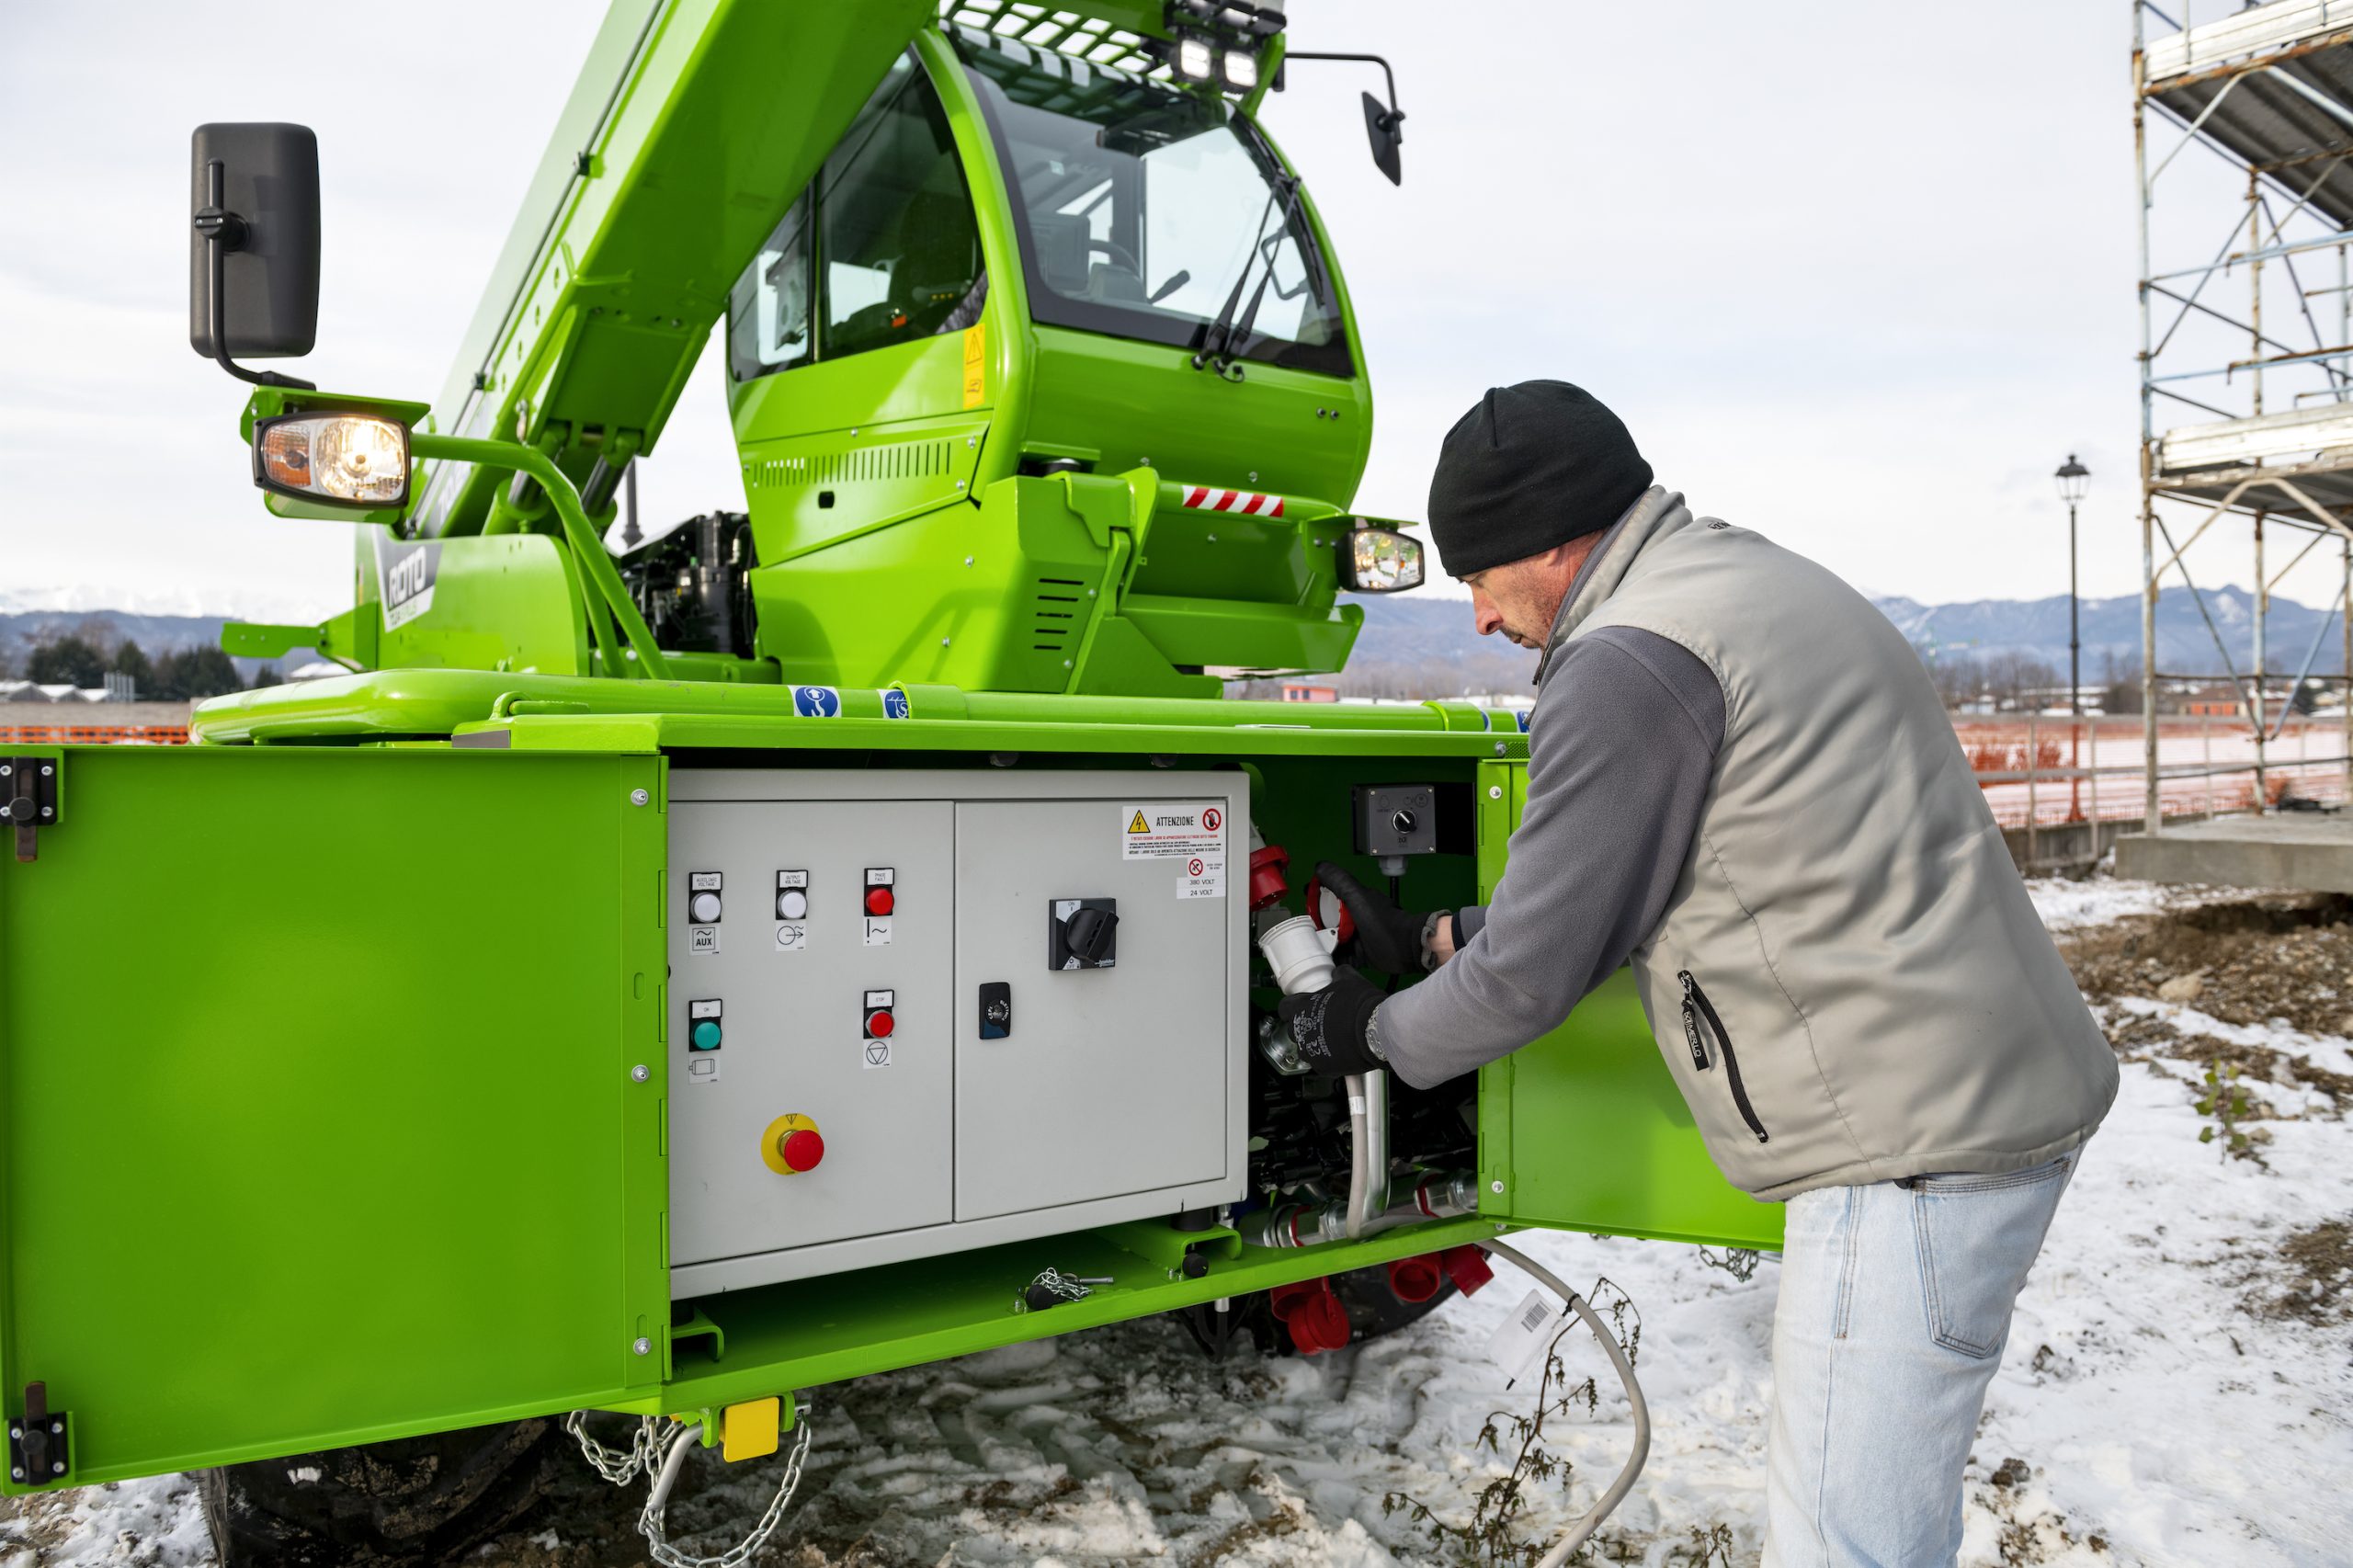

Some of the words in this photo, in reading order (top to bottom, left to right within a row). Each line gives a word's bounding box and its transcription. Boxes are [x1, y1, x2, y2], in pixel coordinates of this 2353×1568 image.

[389, 546, 426, 608] ROTO
[1156, 816, 1194, 827] ATTENZIONE
[696, 938, 712, 947] AUX
[1687, 1023, 1701, 1058] MERLO
